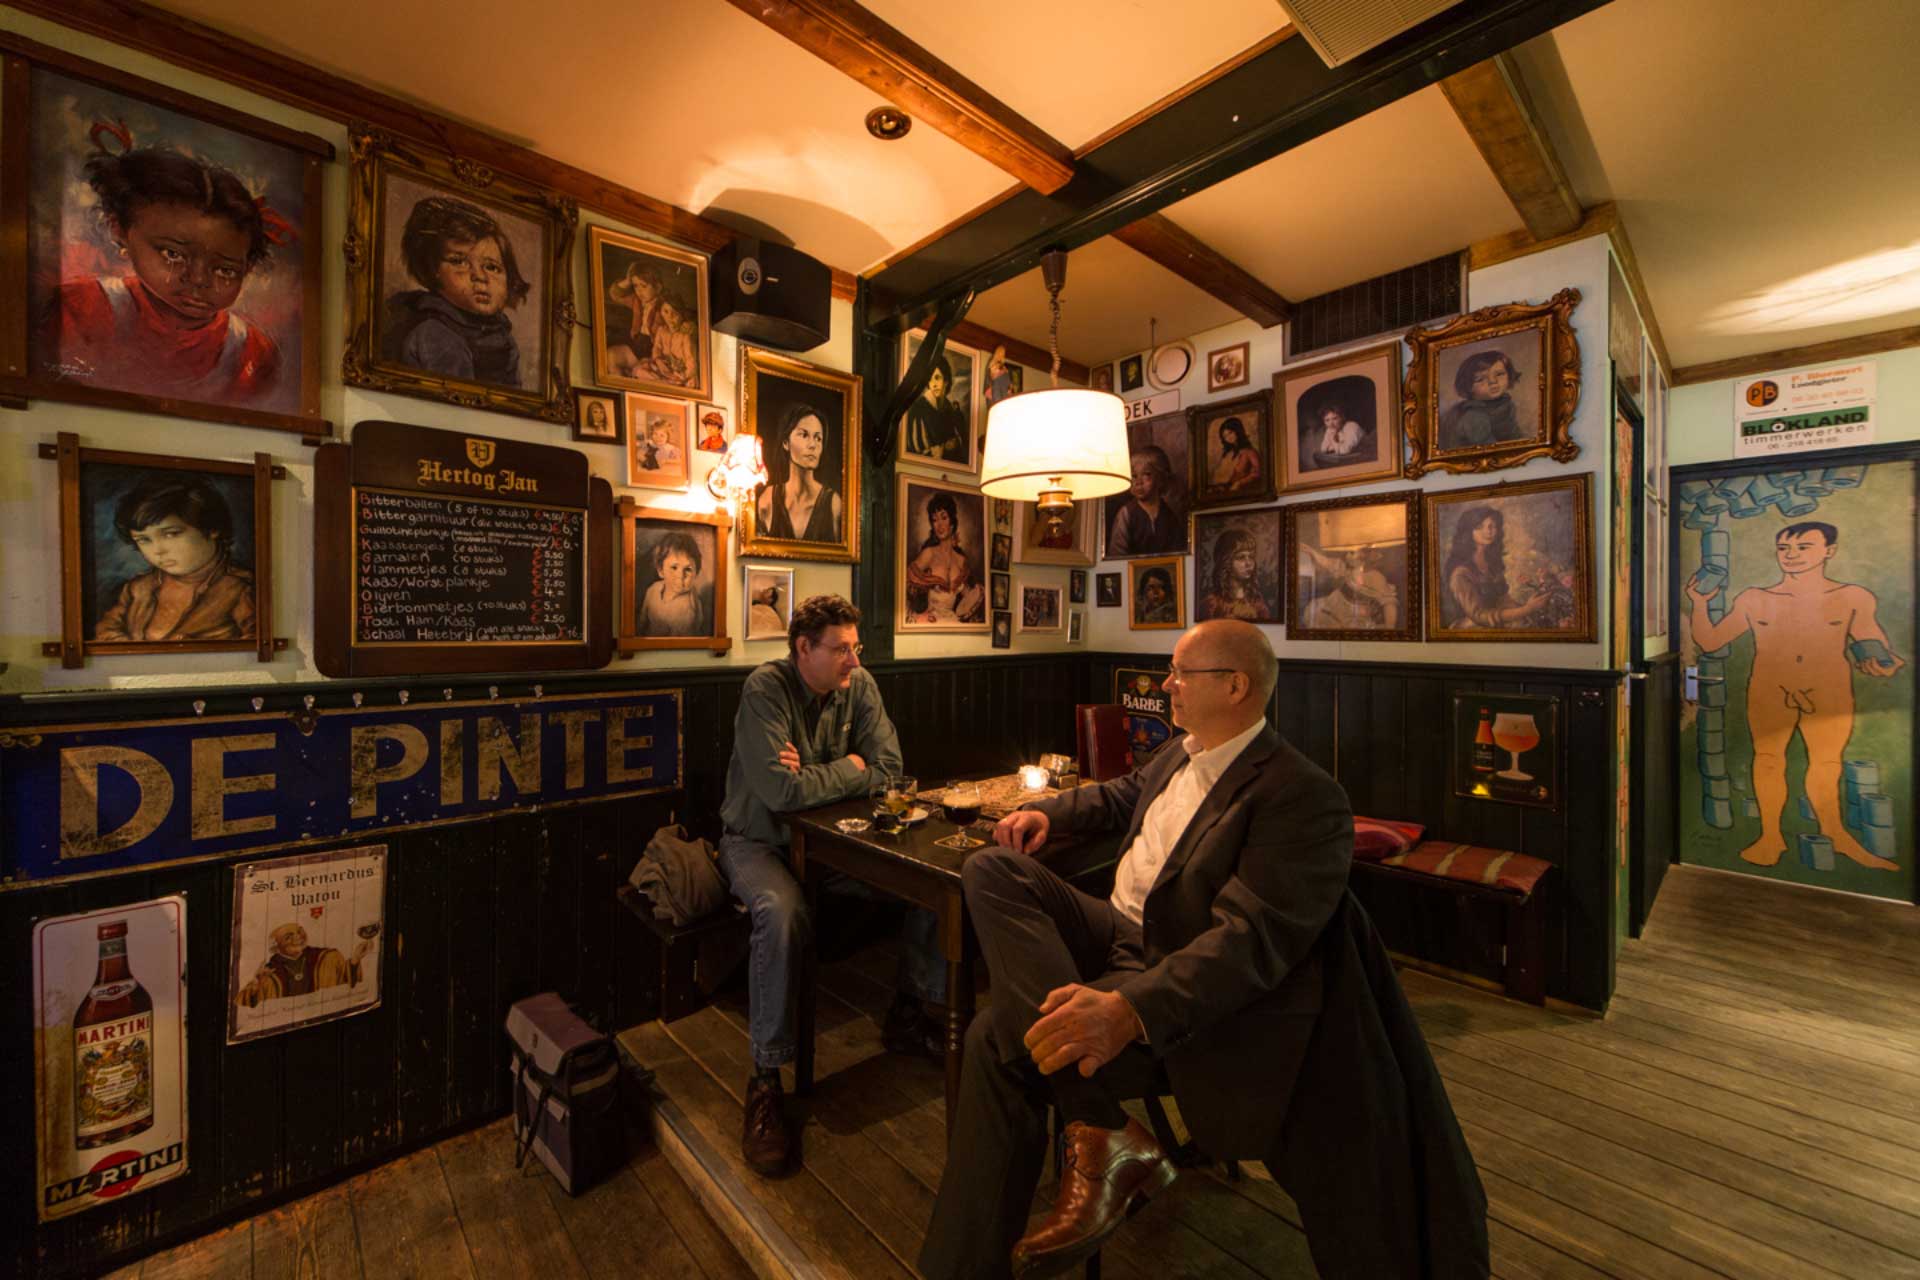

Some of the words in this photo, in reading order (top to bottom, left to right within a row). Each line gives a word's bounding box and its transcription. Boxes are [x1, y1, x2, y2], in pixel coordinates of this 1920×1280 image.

[1742, 411, 1866, 436] BLOKLAND
[1743, 423, 1867, 445] timmerwerken
[417, 458, 496, 491] Hertog
[497, 469, 539, 495] Jan
[360, 493, 442, 510] Bitterballen
[360, 564, 447, 579] Vlammetjes
[362, 602, 474, 616] Bierbommetjes
[1122, 692, 1166, 713] BARBE
[59, 731, 278, 861] DE
[350, 705, 655, 820] PINTE
[251, 878, 279, 893] St.
[285, 866, 375, 889] Bernardus
[291, 889, 340, 907] Watou
[77, 1015, 151, 1048] MARTINI
[49, 1145, 179, 1202] MARTINI
